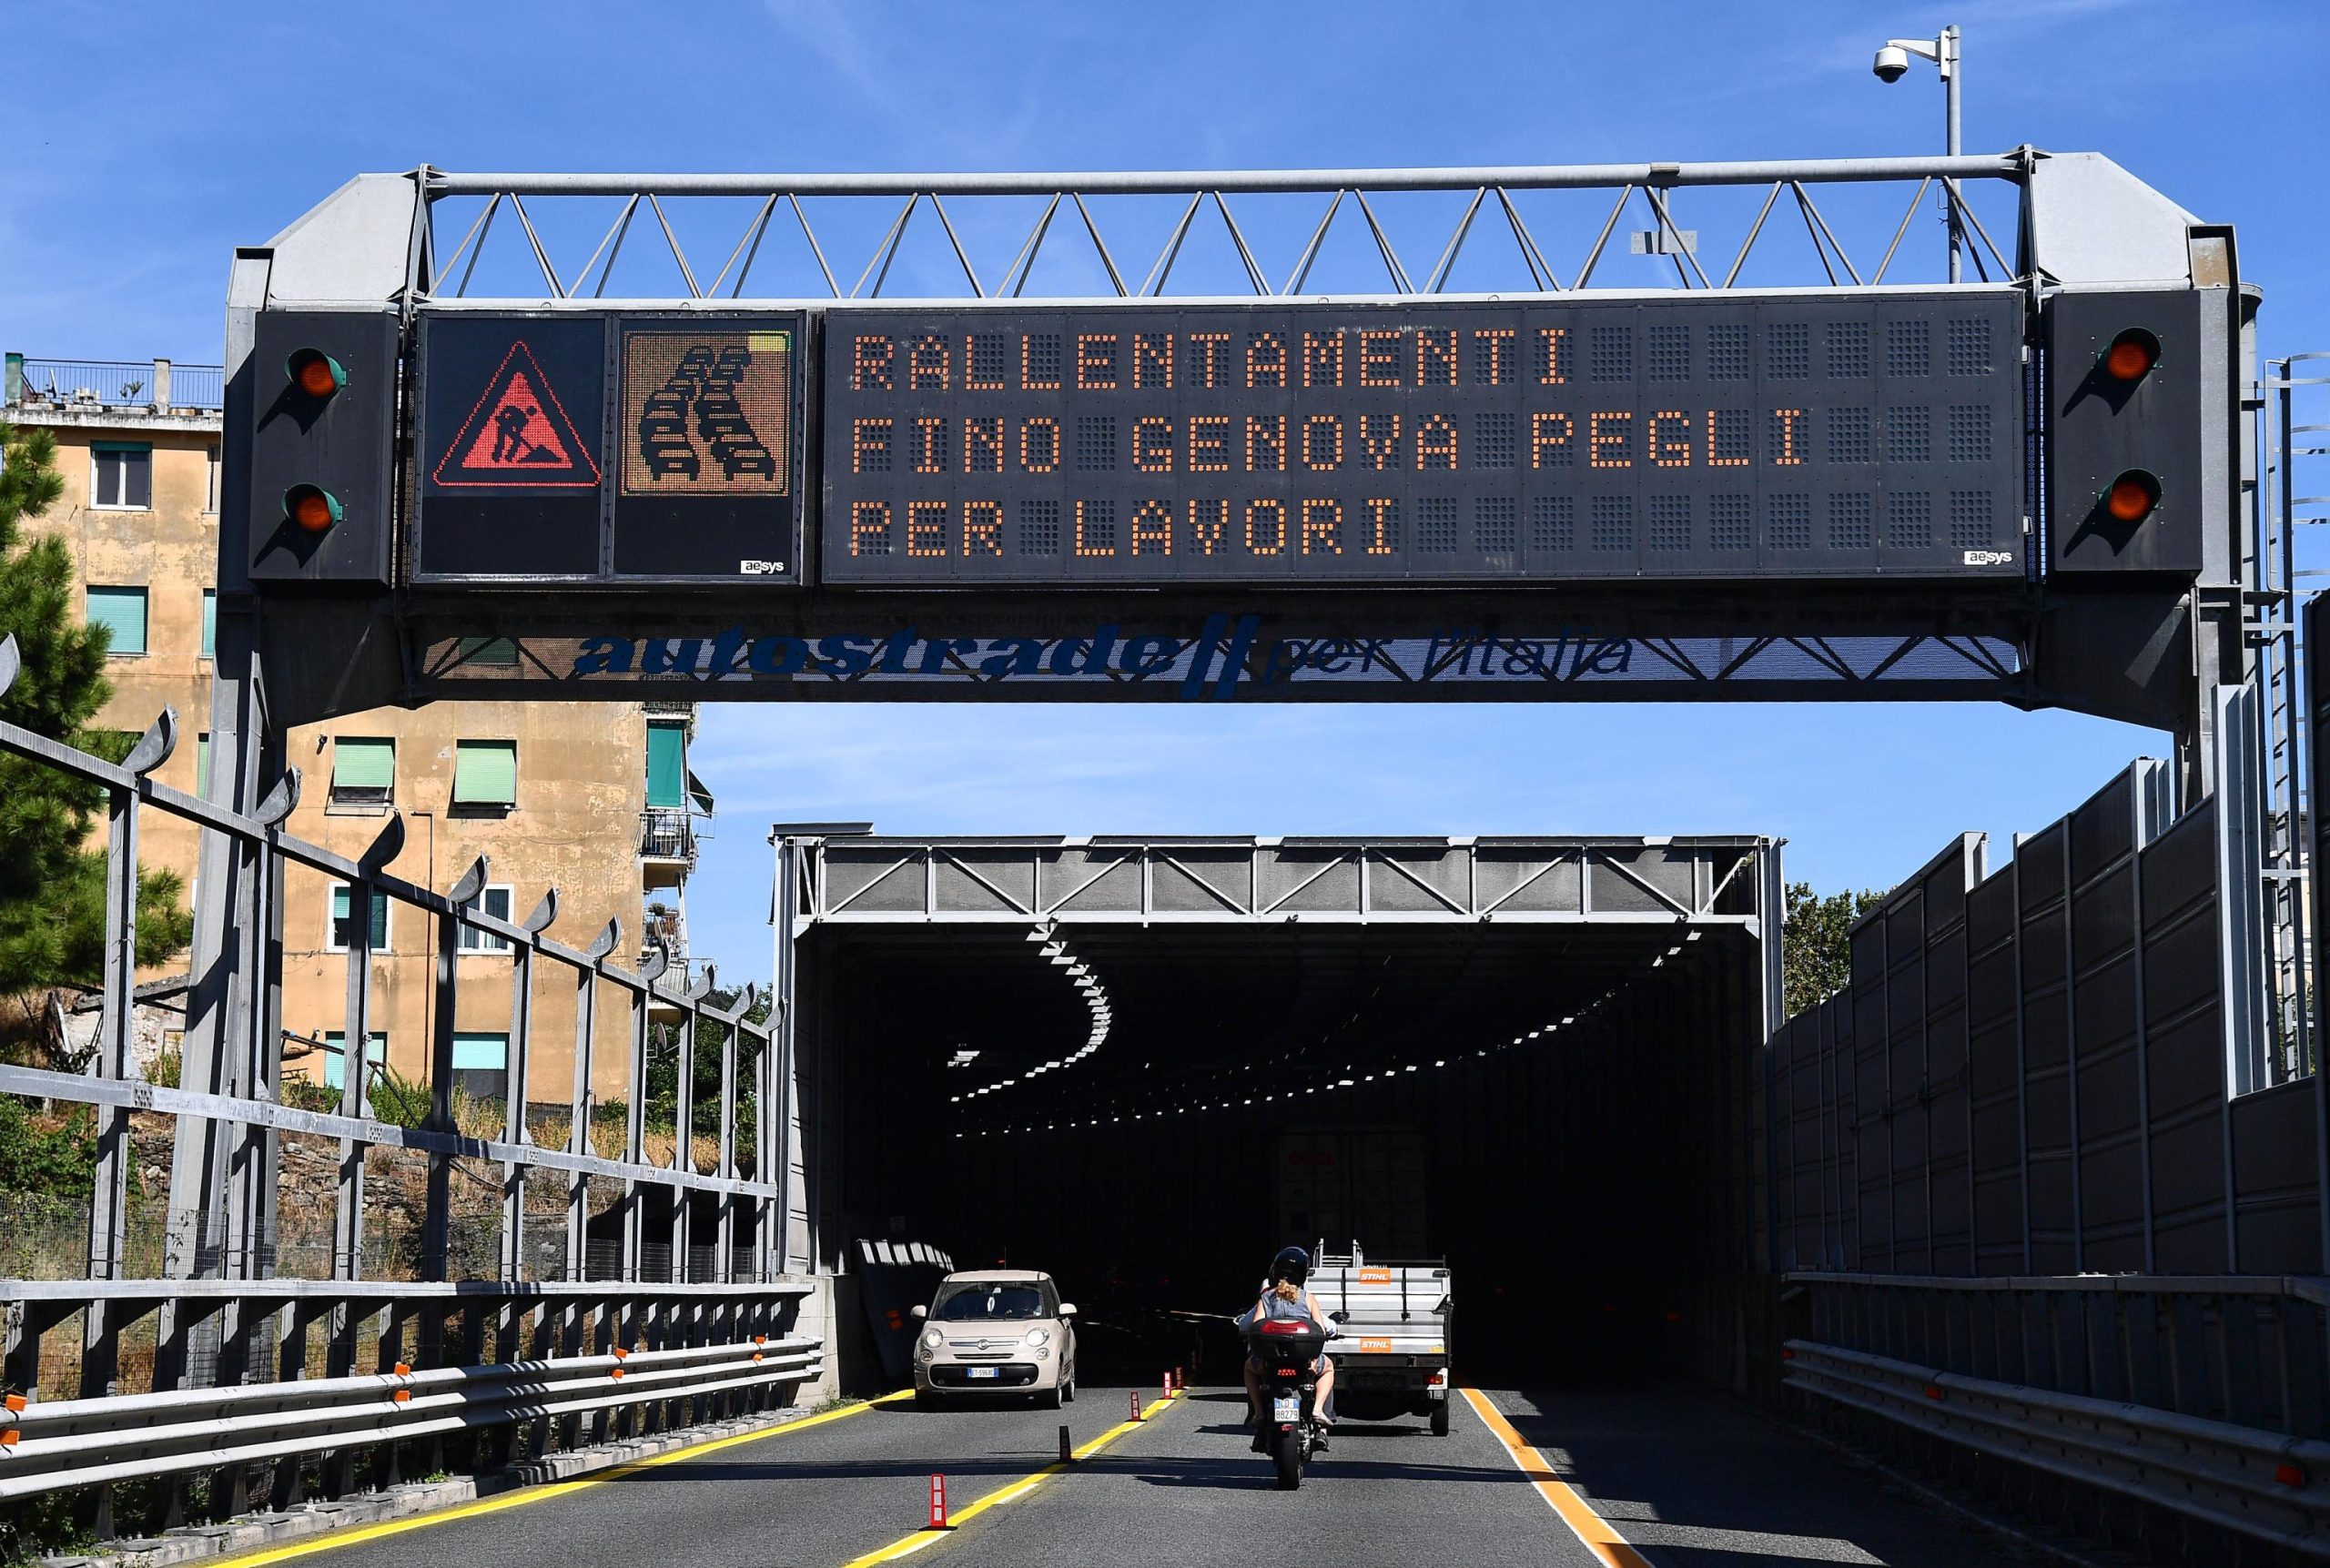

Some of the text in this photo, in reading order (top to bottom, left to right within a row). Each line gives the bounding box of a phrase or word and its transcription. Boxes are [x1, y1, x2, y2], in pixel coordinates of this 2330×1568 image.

[856, 329, 1565, 389] RALLENTAMENTI
[854, 410, 1800, 473] FINO GENOVA PEGLI
[852, 499, 1392, 556] PER LAVORI
[745, 561, 785, 574] aesys
[1969, 551, 2012, 565] aesys
[573, 624, 1180, 676] autostrade
[1263, 636, 1394, 685] per
[1361, 1340, 1389, 1349] STIHL
[1276, 1410, 1298, 1420] 88279
